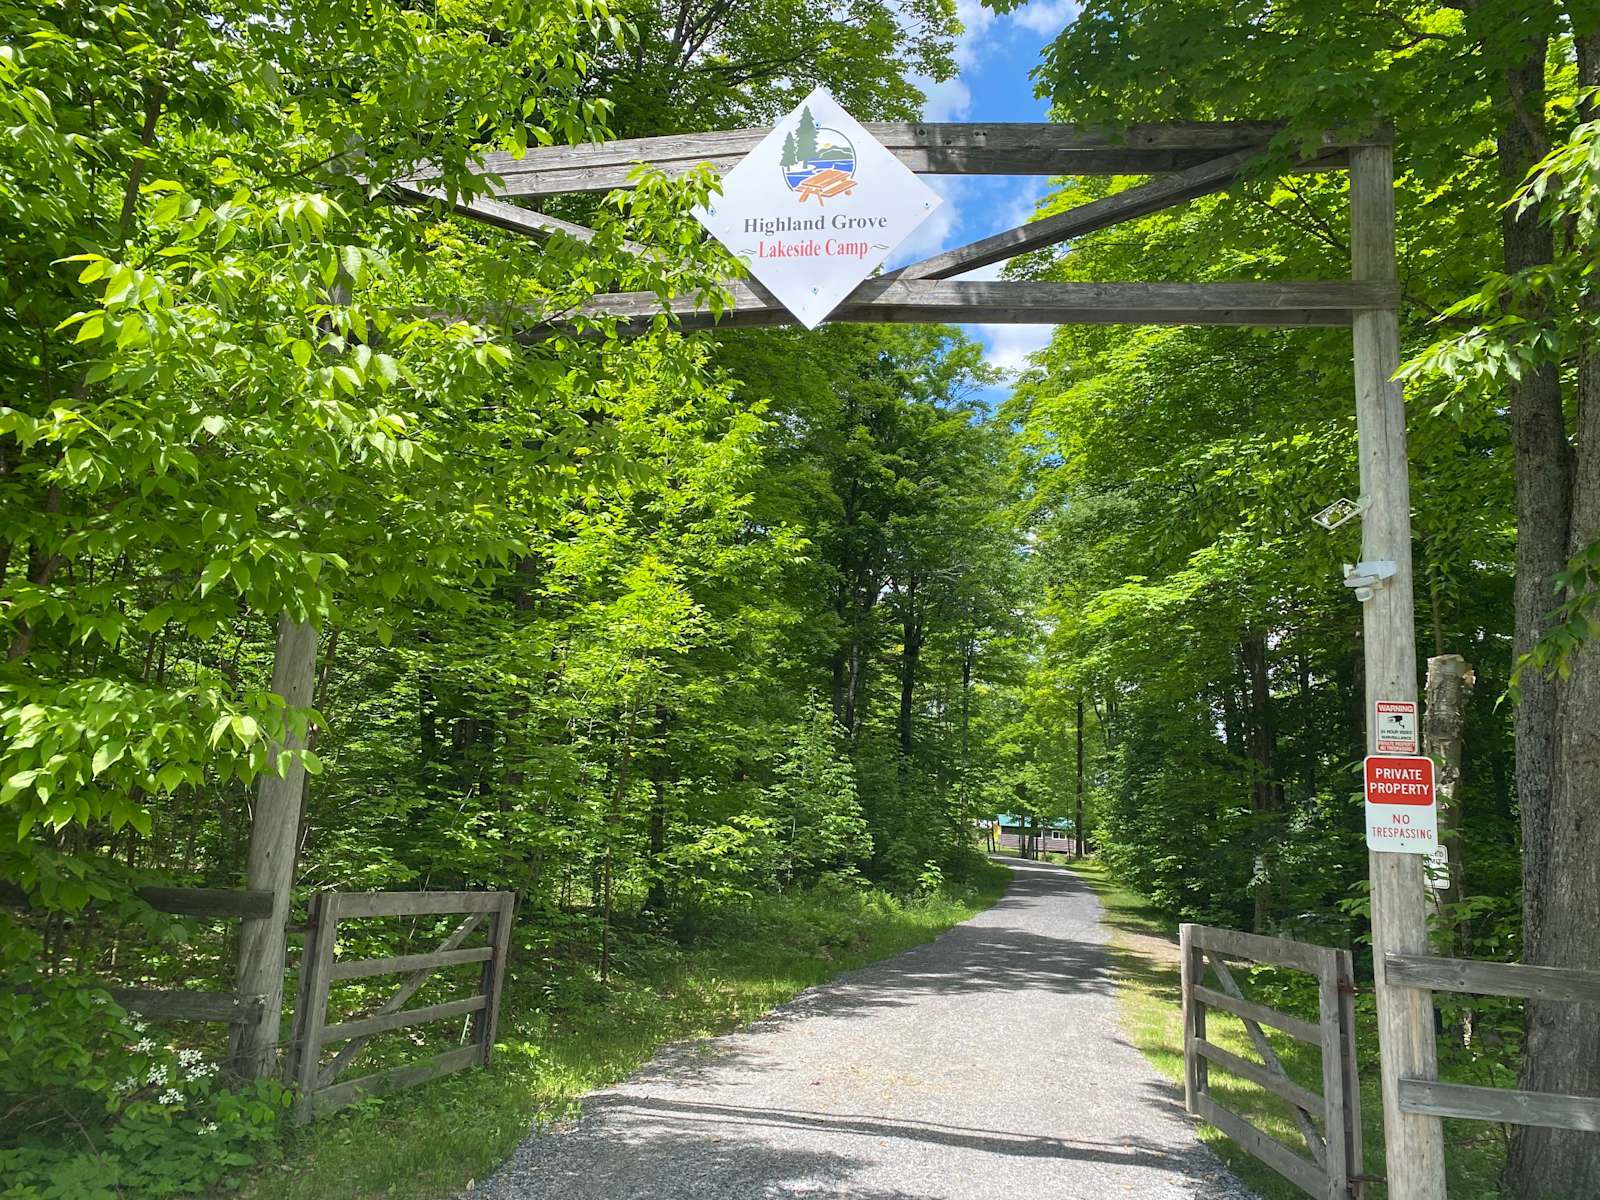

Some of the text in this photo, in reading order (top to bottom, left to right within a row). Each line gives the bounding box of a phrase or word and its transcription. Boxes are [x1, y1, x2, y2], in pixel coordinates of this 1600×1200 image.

[744, 214, 888, 236] Highland Grove
[758, 238, 868, 260] Lakeside Camp
[1378, 703, 1414, 713] WARNING
[1375, 767, 1423, 781] PRIVATE
[1369, 782, 1430, 796] PROPERTY
[1392, 814, 1410, 825] NO
[1372, 826, 1432, 840] TRESPASSING
